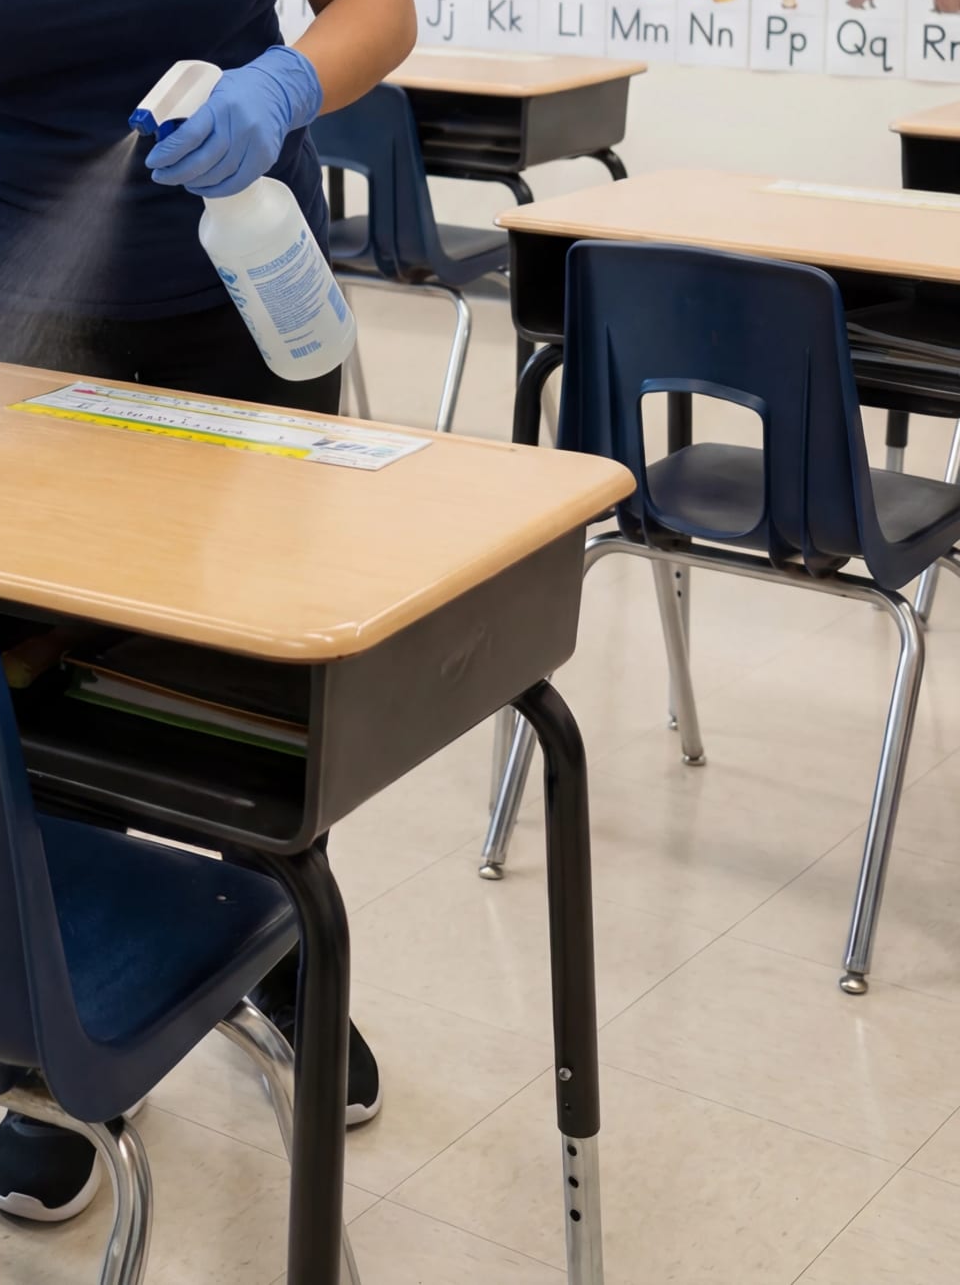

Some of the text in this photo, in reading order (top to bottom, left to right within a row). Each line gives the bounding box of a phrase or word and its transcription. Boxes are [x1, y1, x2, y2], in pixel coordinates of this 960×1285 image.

[488, 0, 522, 32] Kk
[611, 6, 669, 44] Mm
[689, 12, 733, 48] Nn
[766, 15, 807, 66] Pp
[837, 19, 893, 73] Qq
